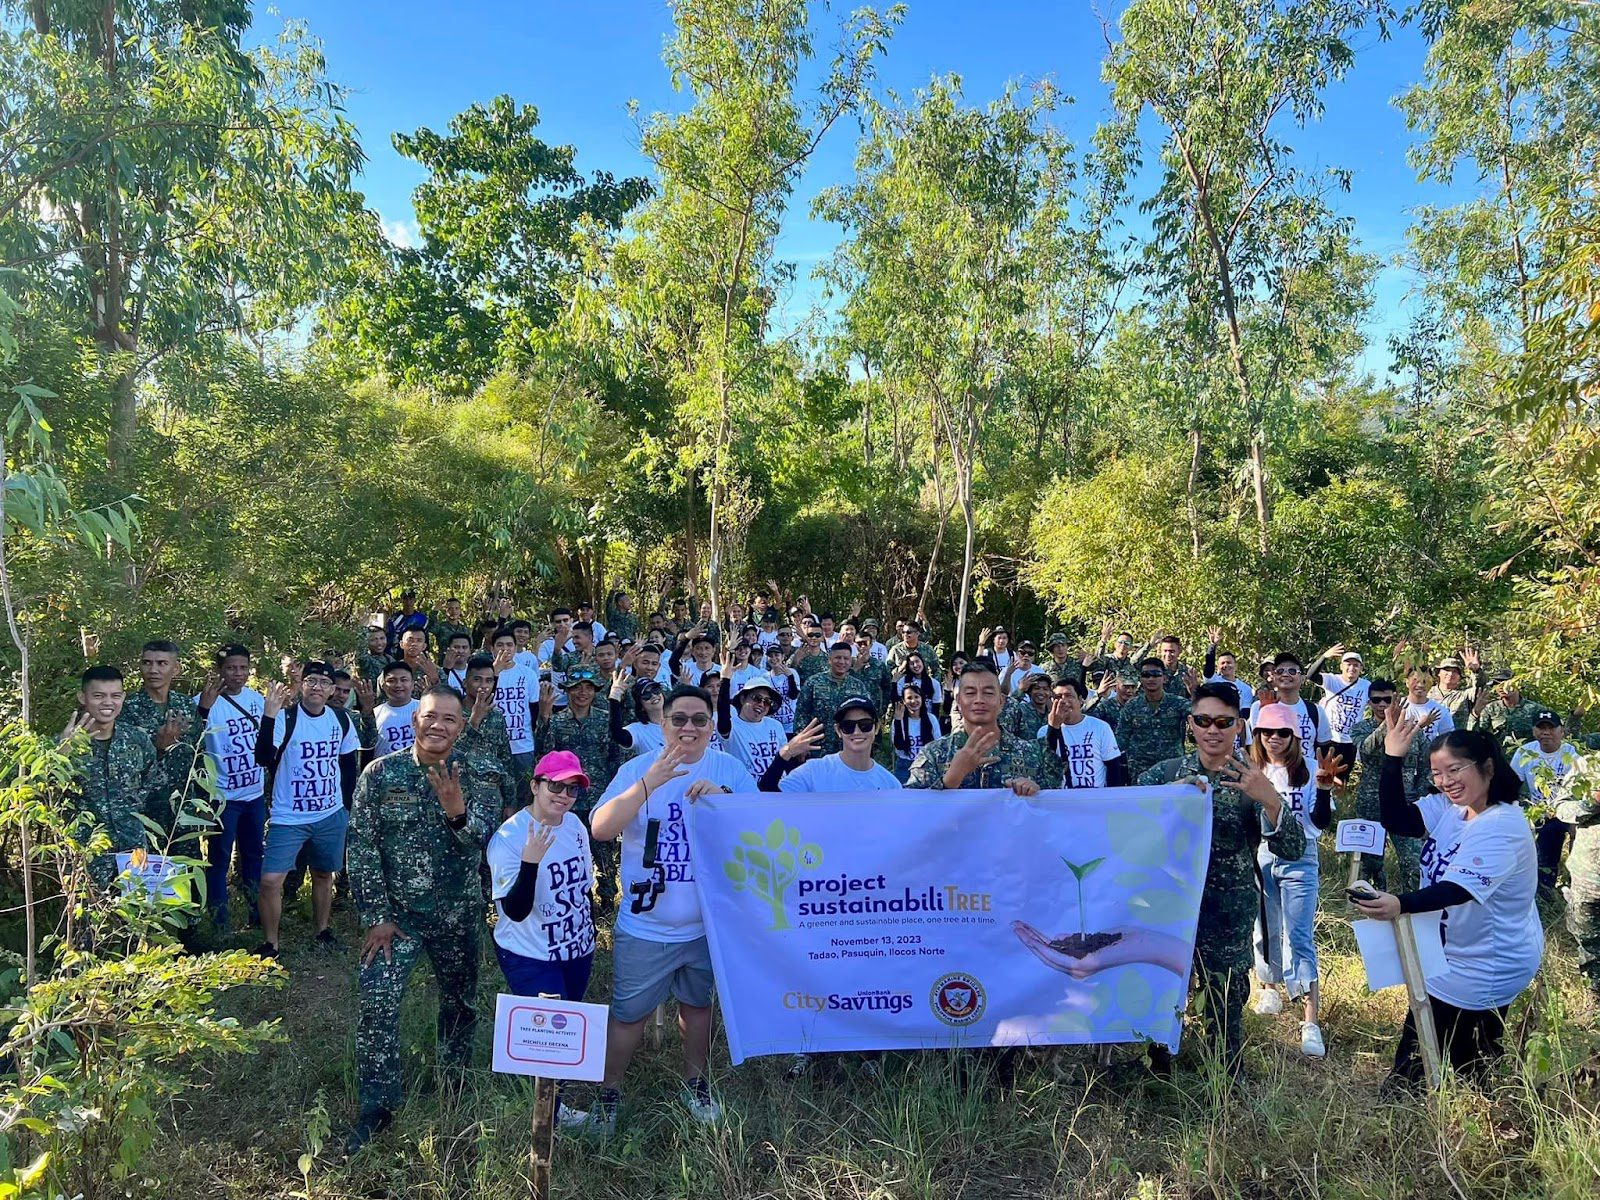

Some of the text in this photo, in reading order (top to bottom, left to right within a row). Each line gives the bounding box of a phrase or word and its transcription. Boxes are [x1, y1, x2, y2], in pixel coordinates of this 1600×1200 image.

[495, 686, 526, 701] BEE
[497, 701, 525, 714] SUS
[504, 714, 525, 728] IN
[386, 725, 416, 742] BE
[300, 740, 339, 760] BEE
[748, 741, 777, 758] BEE
[1068, 743, 1095, 760] EE
[303, 758, 338, 779] SUS
[1071, 759, 1095, 776] US
[226, 768, 262, 790] ABL
[1075, 775, 1095, 788] IN
[291, 777, 338, 799] TAIN
[651, 863, 695, 883] ABL
[799, 873, 886, 897] project
[806, 919, 838, 930] greener
[856, 917, 900, 926] sustainable
[901, 917, 925, 925] place,
[943, 916, 960, 924] tree
[978, 917, 996, 925] time.
[831, 935, 922, 947] November 13, 2023
[808, 947, 945, 961] Tadao, Pasuquin, Ilocos Norte
